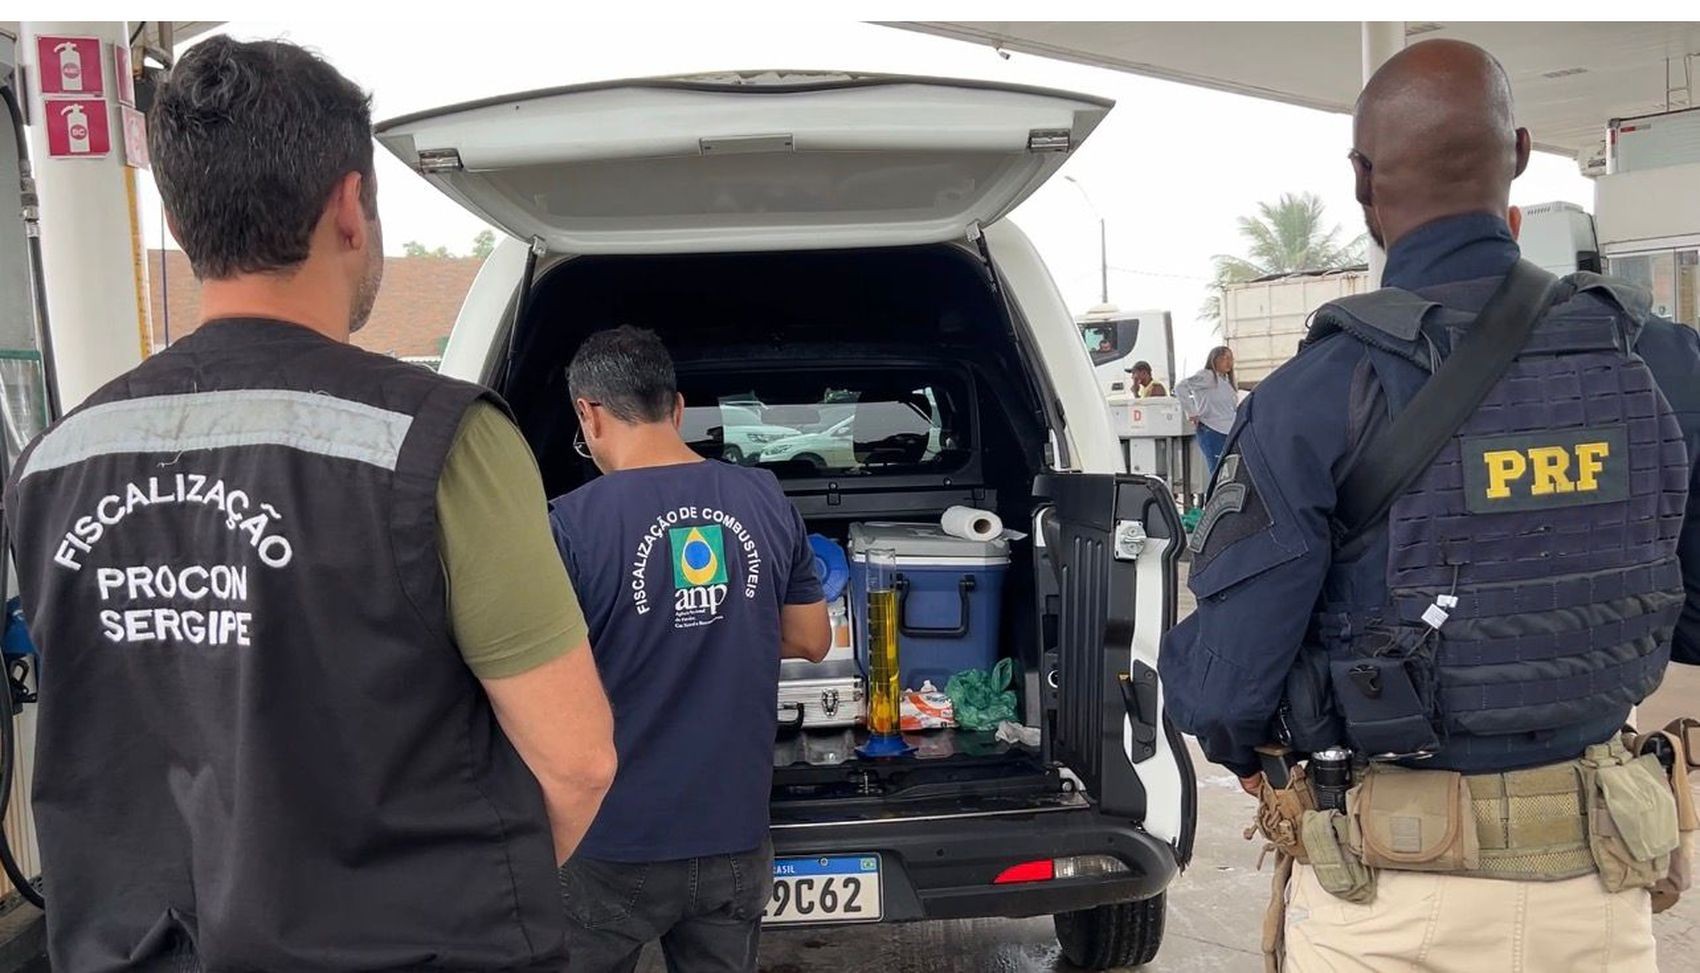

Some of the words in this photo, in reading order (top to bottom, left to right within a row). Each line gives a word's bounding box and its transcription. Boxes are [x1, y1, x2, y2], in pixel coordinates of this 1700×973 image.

[1134, 410, 1142, 421] D
[1483, 442, 1609, 499] PRF
[54, 473, 293, 571] FISCALIZAÇÃO
[631, 511, 678, 615] FISCALIZAÇÃO
[679, 506, 698, 520] DE
[702, 508, 762, 599] COMBUSTÍVEIS
[97, 565, 247, 600] PROCON
[674, 583, 728, 615] anp
[100, 608, 252, 646] SERGIPE
[773, 865, 795, 874] ASIL
[763, 876, 862, 917] 9C62
